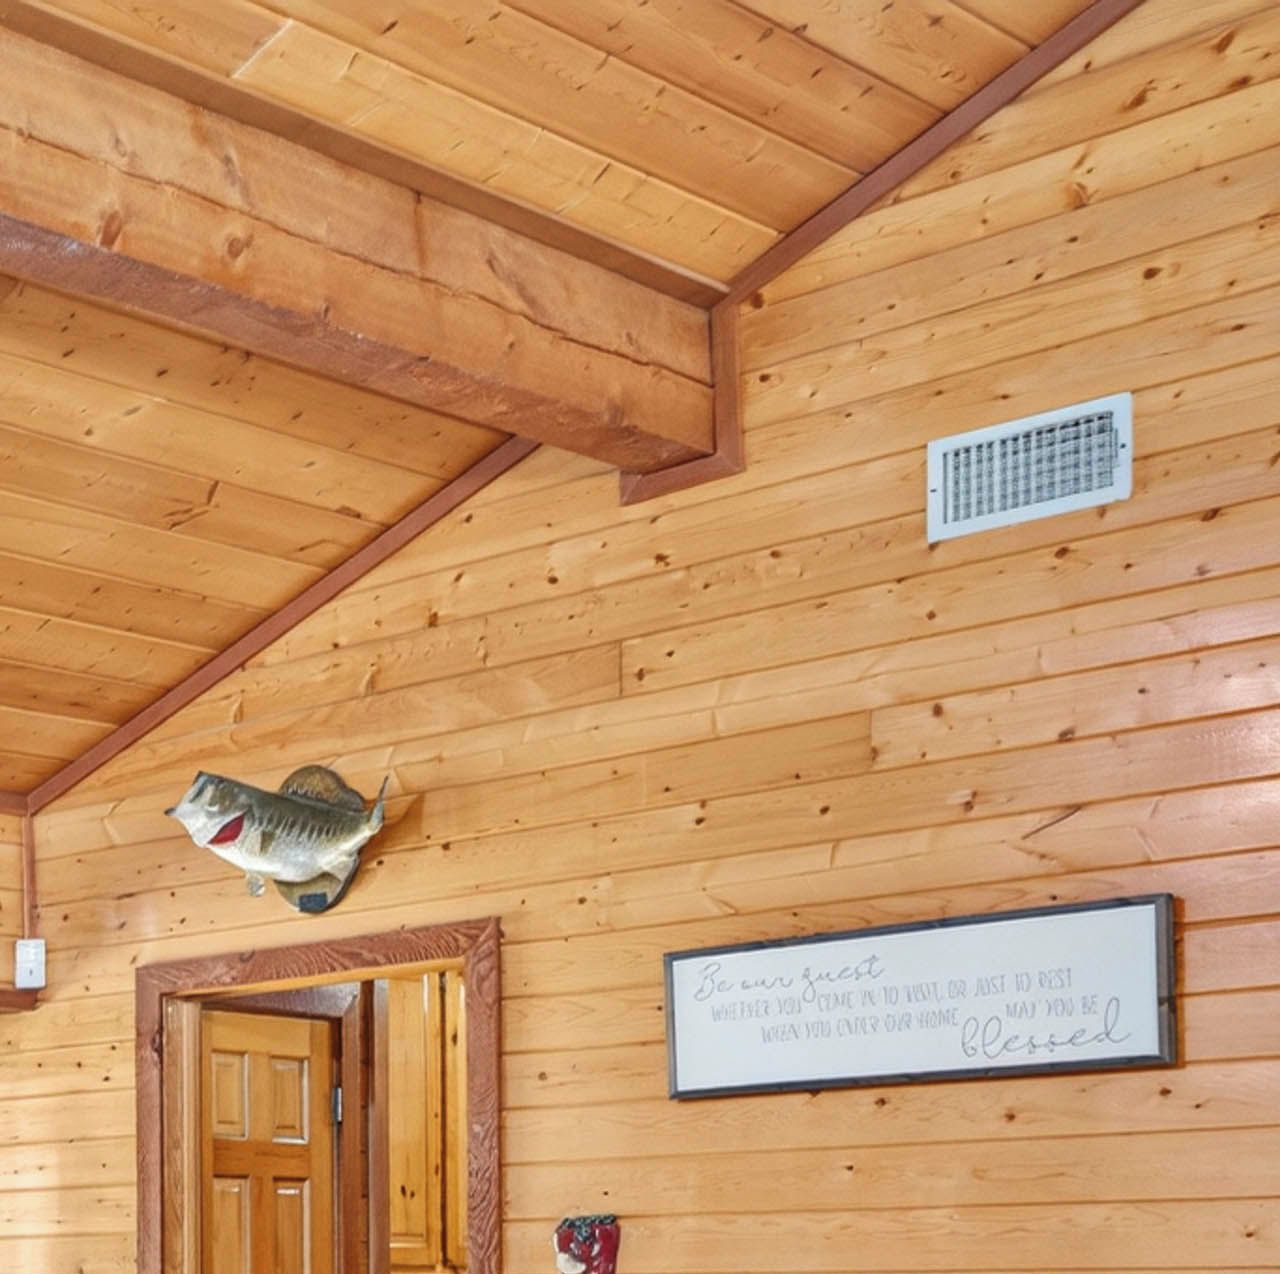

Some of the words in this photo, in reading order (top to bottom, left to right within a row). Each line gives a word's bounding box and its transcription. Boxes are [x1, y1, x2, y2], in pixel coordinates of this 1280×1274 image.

[693, 962, 734, 1001] Be
[801, 954, 885, 1003] guest
[974, 974, 1005, 997] JUST
[1038, 968, 1072, 989] REST
[962, 996, 1132, 1059] blessed
